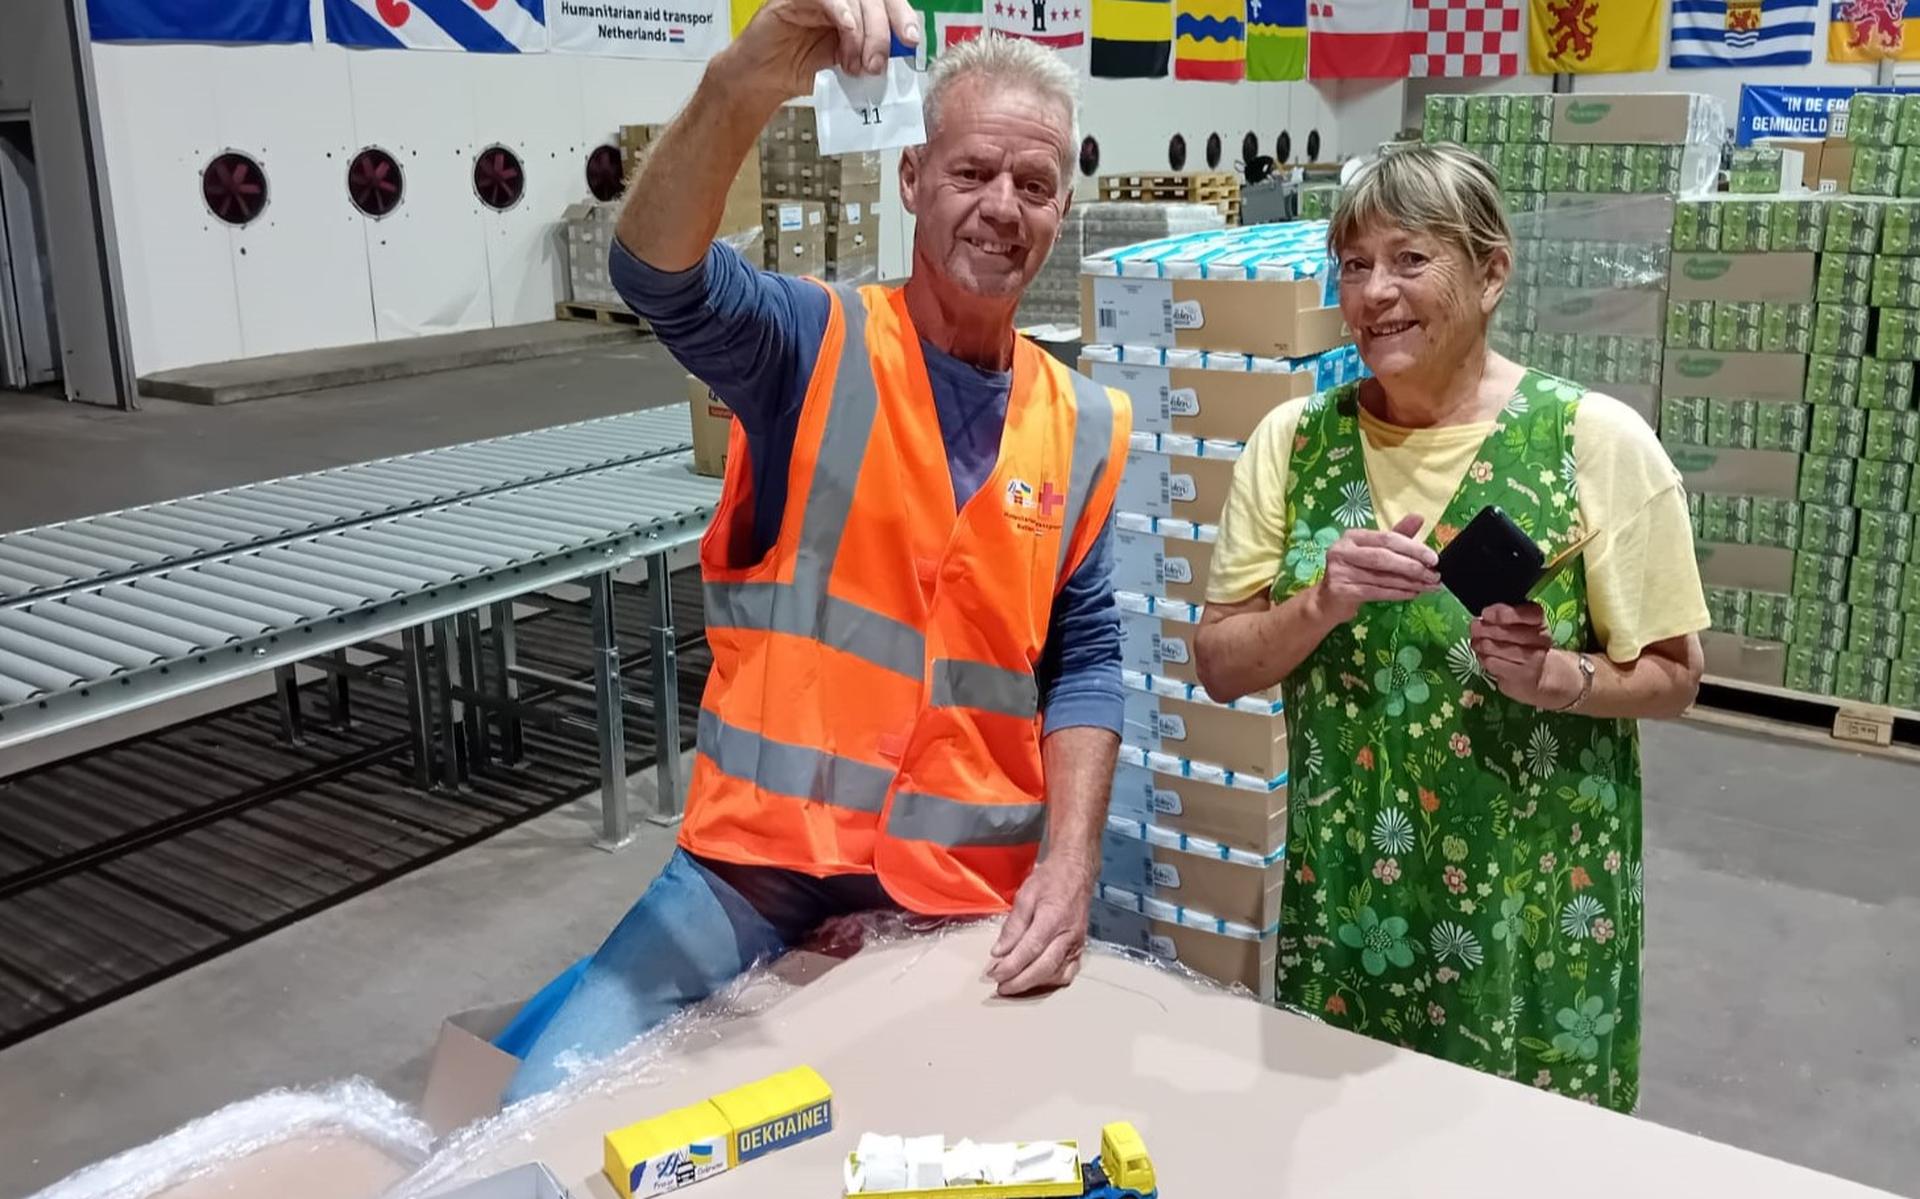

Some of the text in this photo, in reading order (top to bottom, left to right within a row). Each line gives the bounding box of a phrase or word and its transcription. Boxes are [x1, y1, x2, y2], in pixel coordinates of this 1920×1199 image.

[561, 2, 643, 20] Humanitarian
[643, 9, 661, 22] aid
[598, 25, 667, 42] Netherlands
[1804, 98, 1824, 112] DE
[861, 107, 883, 126] 11
[1752, 117, 1828, 133] GEMIDDELD
